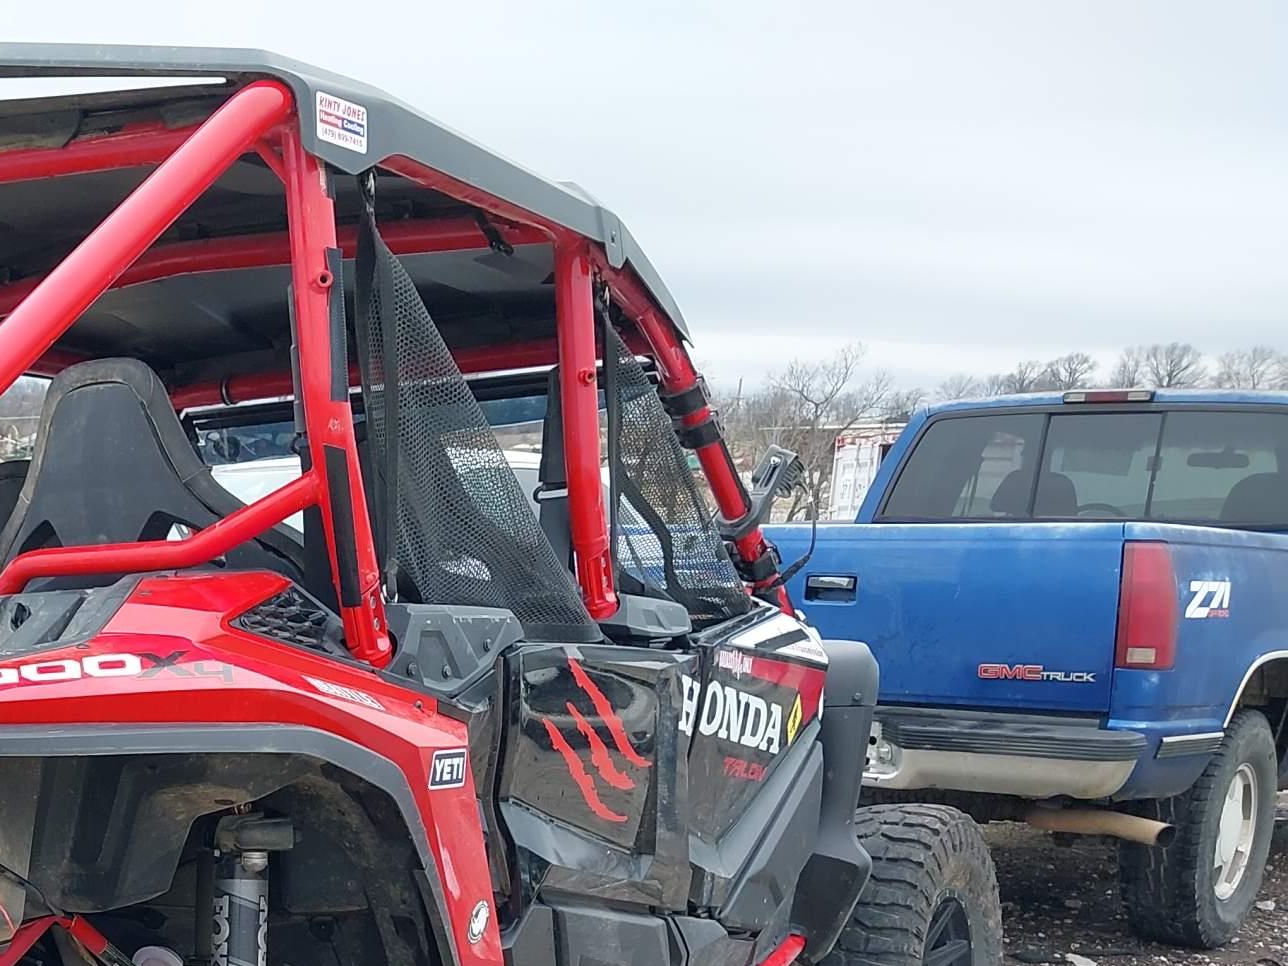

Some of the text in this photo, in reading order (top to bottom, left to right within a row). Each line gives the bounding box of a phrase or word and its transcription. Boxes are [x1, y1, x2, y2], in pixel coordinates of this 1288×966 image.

[319, 96, 366, 122] KINTY JONES
[343, 119, 364, 137] Cooling
[1184, 580, 1231, 618] Z71
[977, 663, 1097, 683] GMC TRUCK
[678, 674, 783, 755] HONDA
[435, 756, 464, 781] YETI
